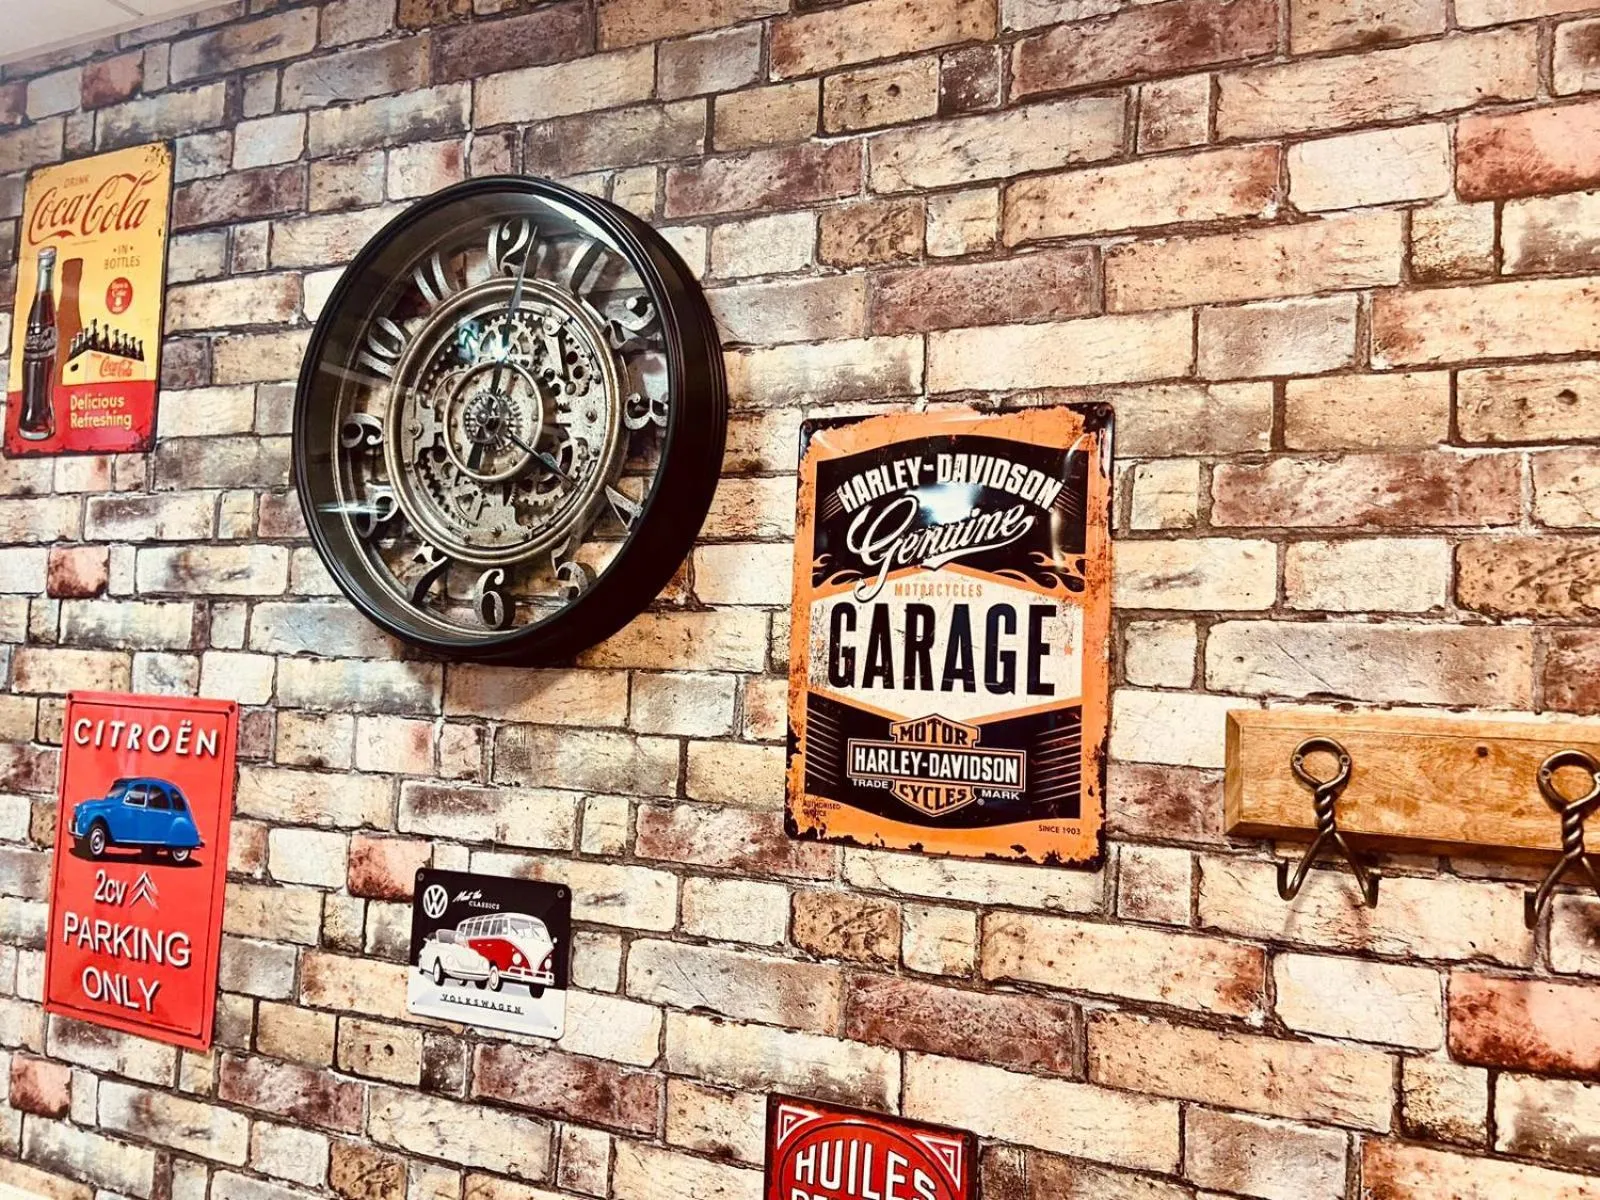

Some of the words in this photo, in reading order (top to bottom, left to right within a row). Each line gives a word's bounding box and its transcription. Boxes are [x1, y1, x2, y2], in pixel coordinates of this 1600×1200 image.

[103, 255, 141, 270] BOTTLES
[70, 393, 125, 412] Delicious
[70, 410, 133, 430] Refreshing
[836, 453, 1064, 514] HARLEY-DAVIDSON
[846, 493, 1036, 603] Genuine
[894, 582, 983, 598] MOTORCYCLES
[827, 602, 1057, 696] GARAGE
[73, 718, 219, 757] CITROËN
[900, 717, 968, 745] MOTOR
[854, 747, 1018, 783] HARLEY-DAVIDSON
[852, 778, 889, 789] TRADE
[981, 789, 1020, 800] MARK
[900, 784, 967, 810] CYCLES
[1038, 825, 1060, 833] SINCE
[1062, 827, 1081, 835] 1903
[468, 900, 500, 910] CLASSICS
[64, 911, 191, 969] PARKING
[81, 966, 160, 1013] ONLY
[441, 994, 523, 1015] VOLKSWAGEN
[795, 1139, 936, 1200] HUILES
